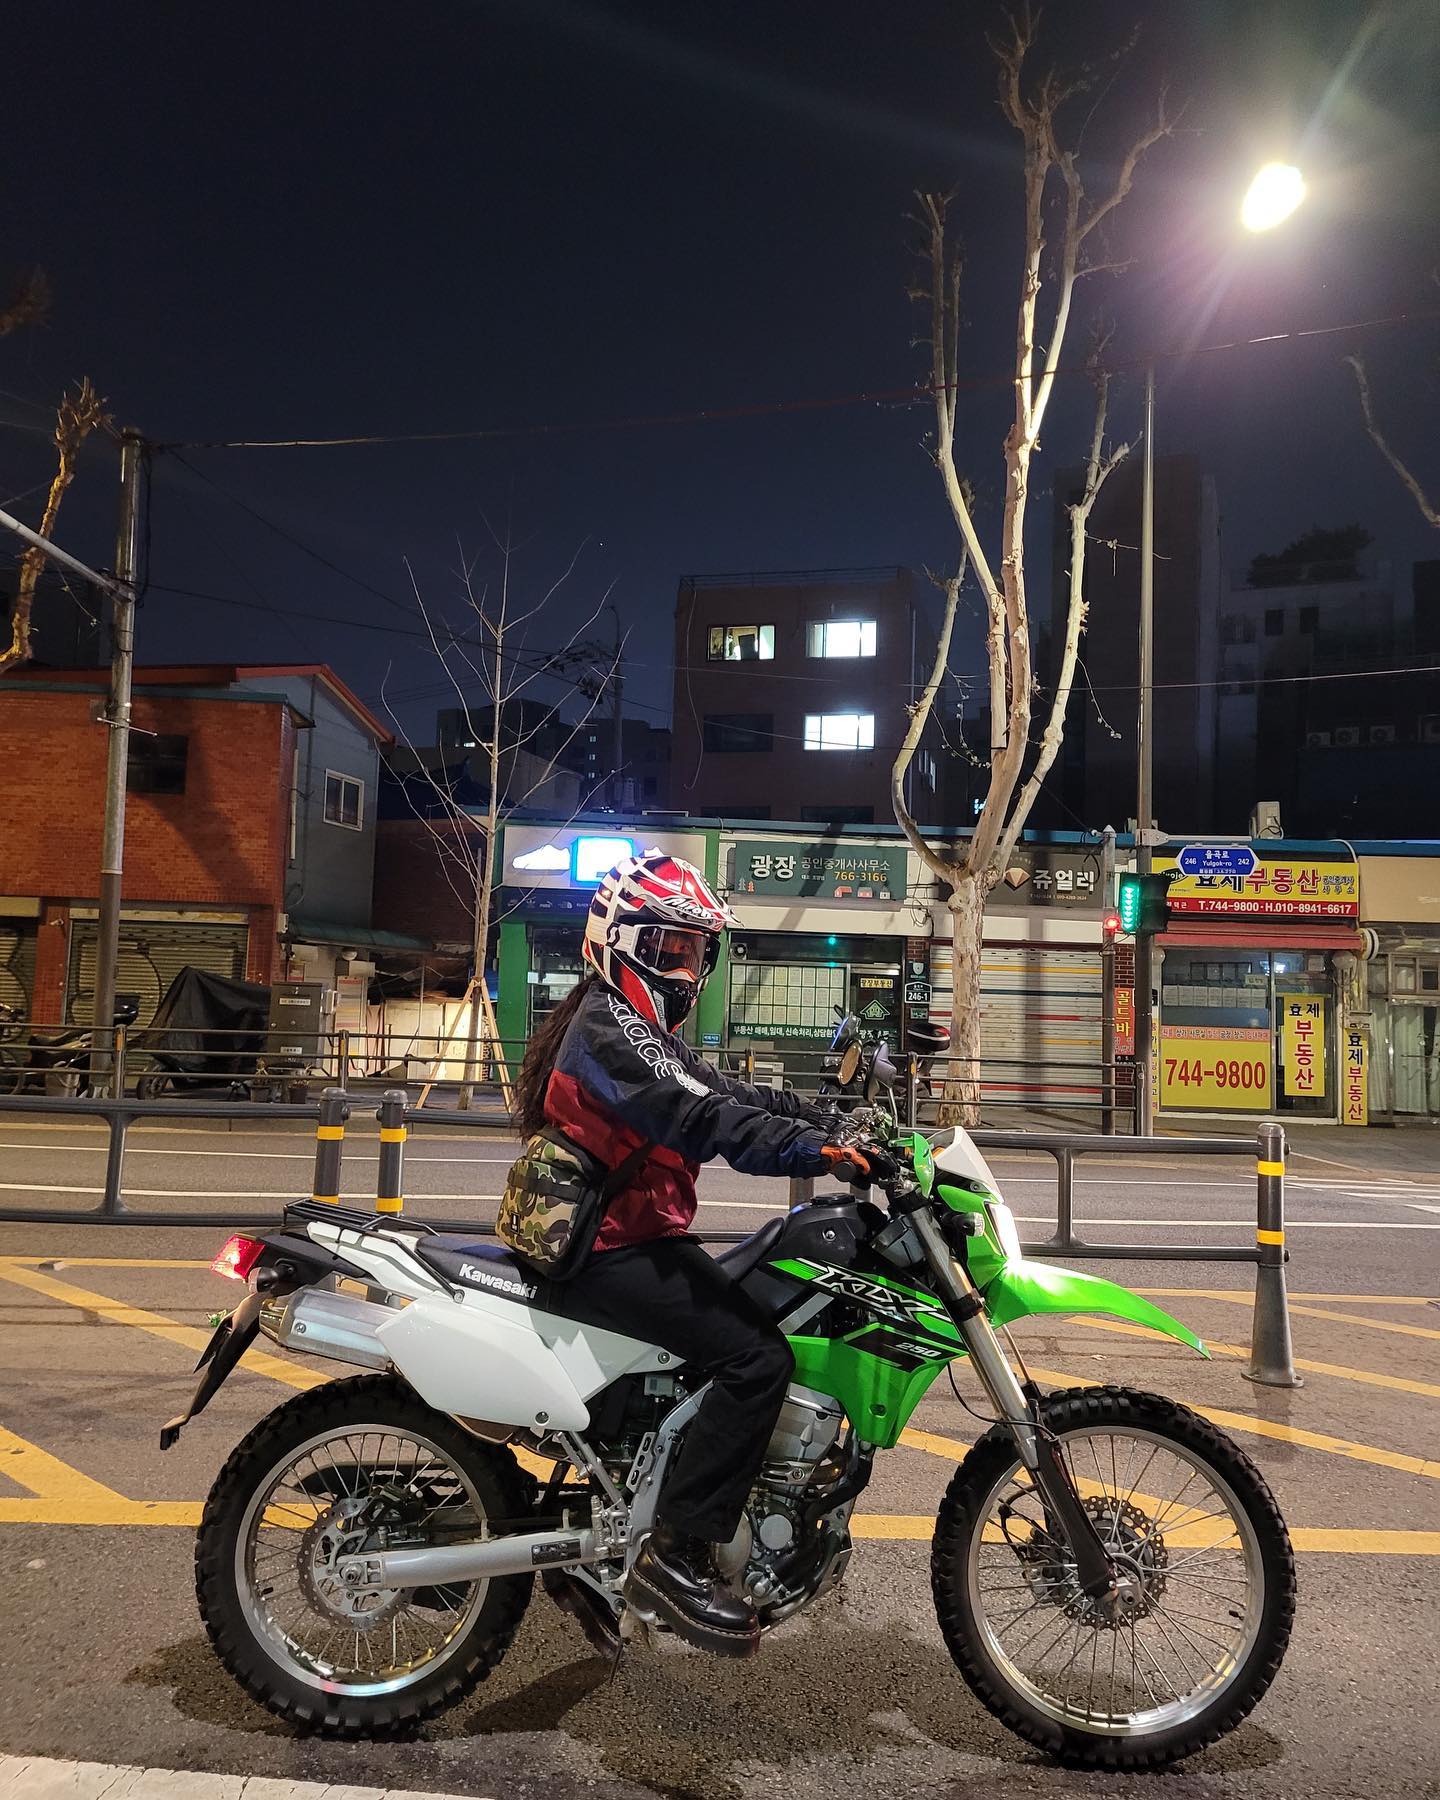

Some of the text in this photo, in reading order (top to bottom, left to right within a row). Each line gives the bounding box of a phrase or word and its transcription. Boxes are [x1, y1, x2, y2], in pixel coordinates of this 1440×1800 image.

[1205, 850, 1230, 859] 율곡로
[751, 854, 890, 879] 광장 공인중개사사무소
[834, 871, 887, 882] 766-3166
[1033, 869, 1094, 892] 쥬얼리
[908, 992, 928, 1001] 246-1
[1289, 1002, 1320, 1019] 효제
[733, 1025, 753, 1035] 부동산
[1294, 1020, 1314, 1090] 부동산
[1165, 1058, 1266, 1090] 744-9800
[1347, 1032, 1363, 1121] 효제부동산
[459, 1263, 538, 1299] Kawasaki
[895, 1342, 942, 1358] 250
